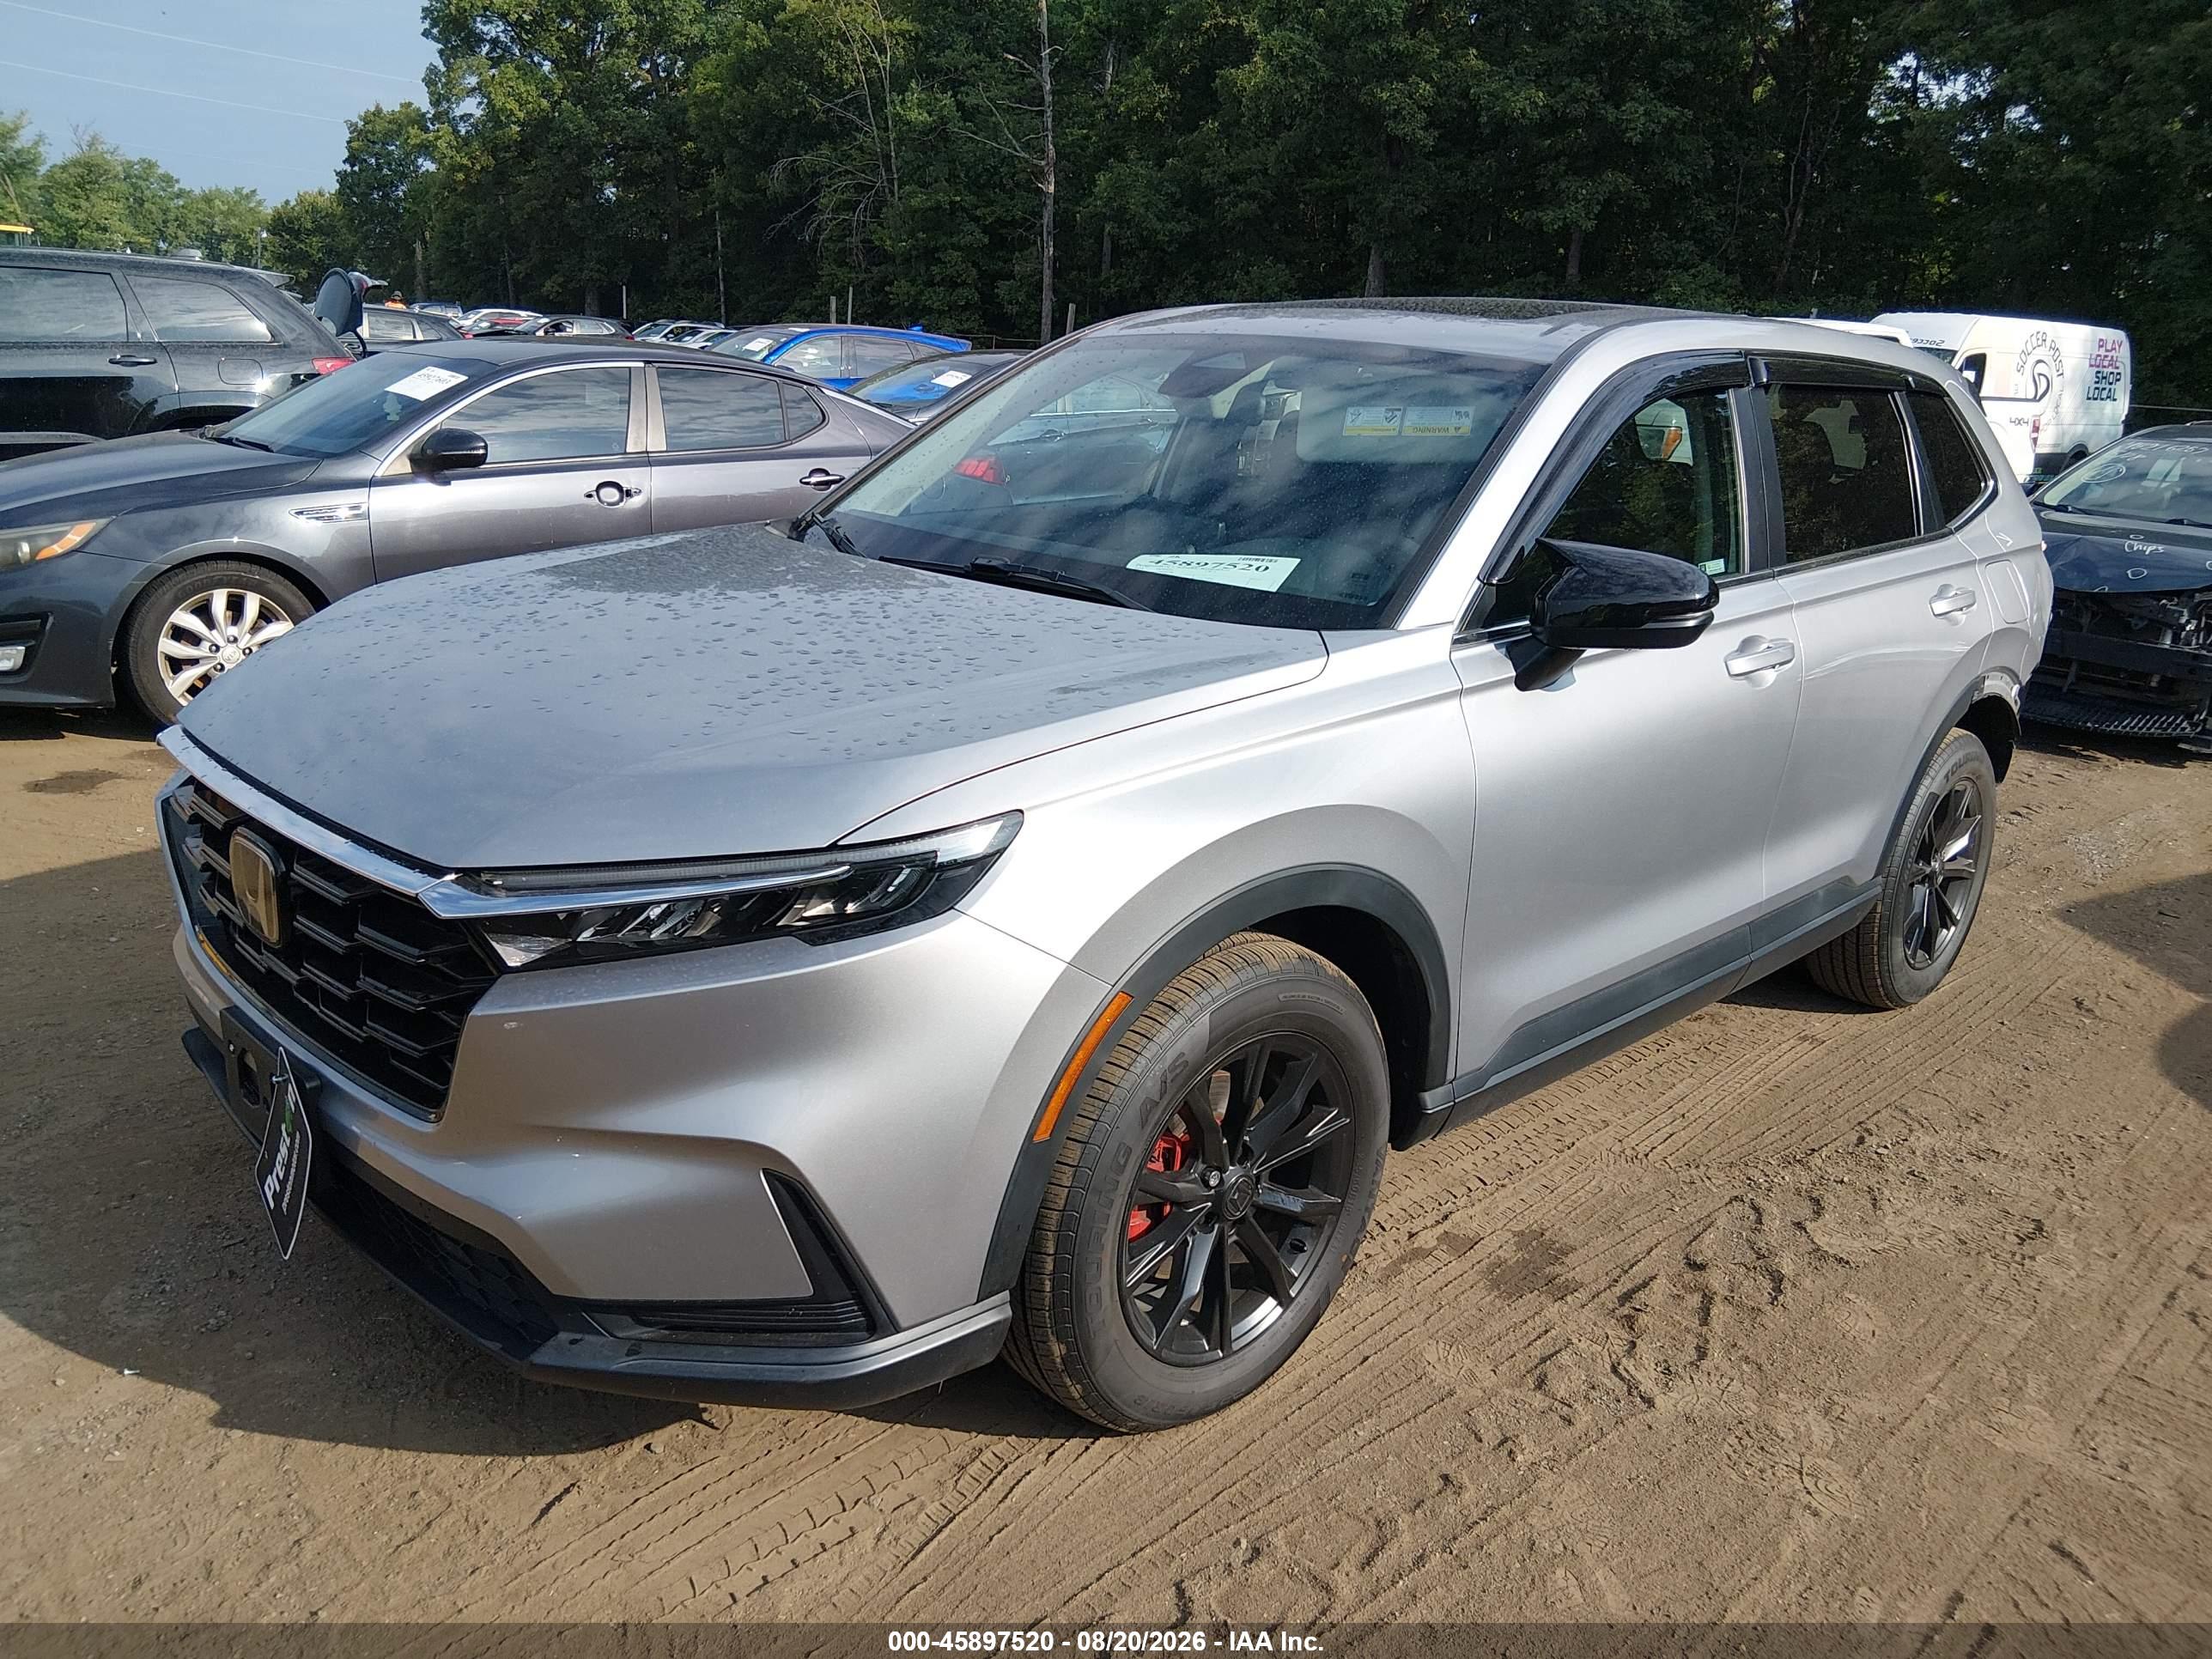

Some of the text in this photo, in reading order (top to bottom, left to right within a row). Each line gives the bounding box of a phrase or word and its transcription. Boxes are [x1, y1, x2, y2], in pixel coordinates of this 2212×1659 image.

[2098, 338, 2123, 353] PLAY
[2016, 331, 2064, 379] SOCCER POST
[2088, 353, 2120, 369] LOCAL
[2094, 371, 2122, 386] SHOP
[2086, 386, 2118, 402] LOCAL
[2124, 540, 2165, 555] Chips
[1149, 558, 1270, 573] 45897520
